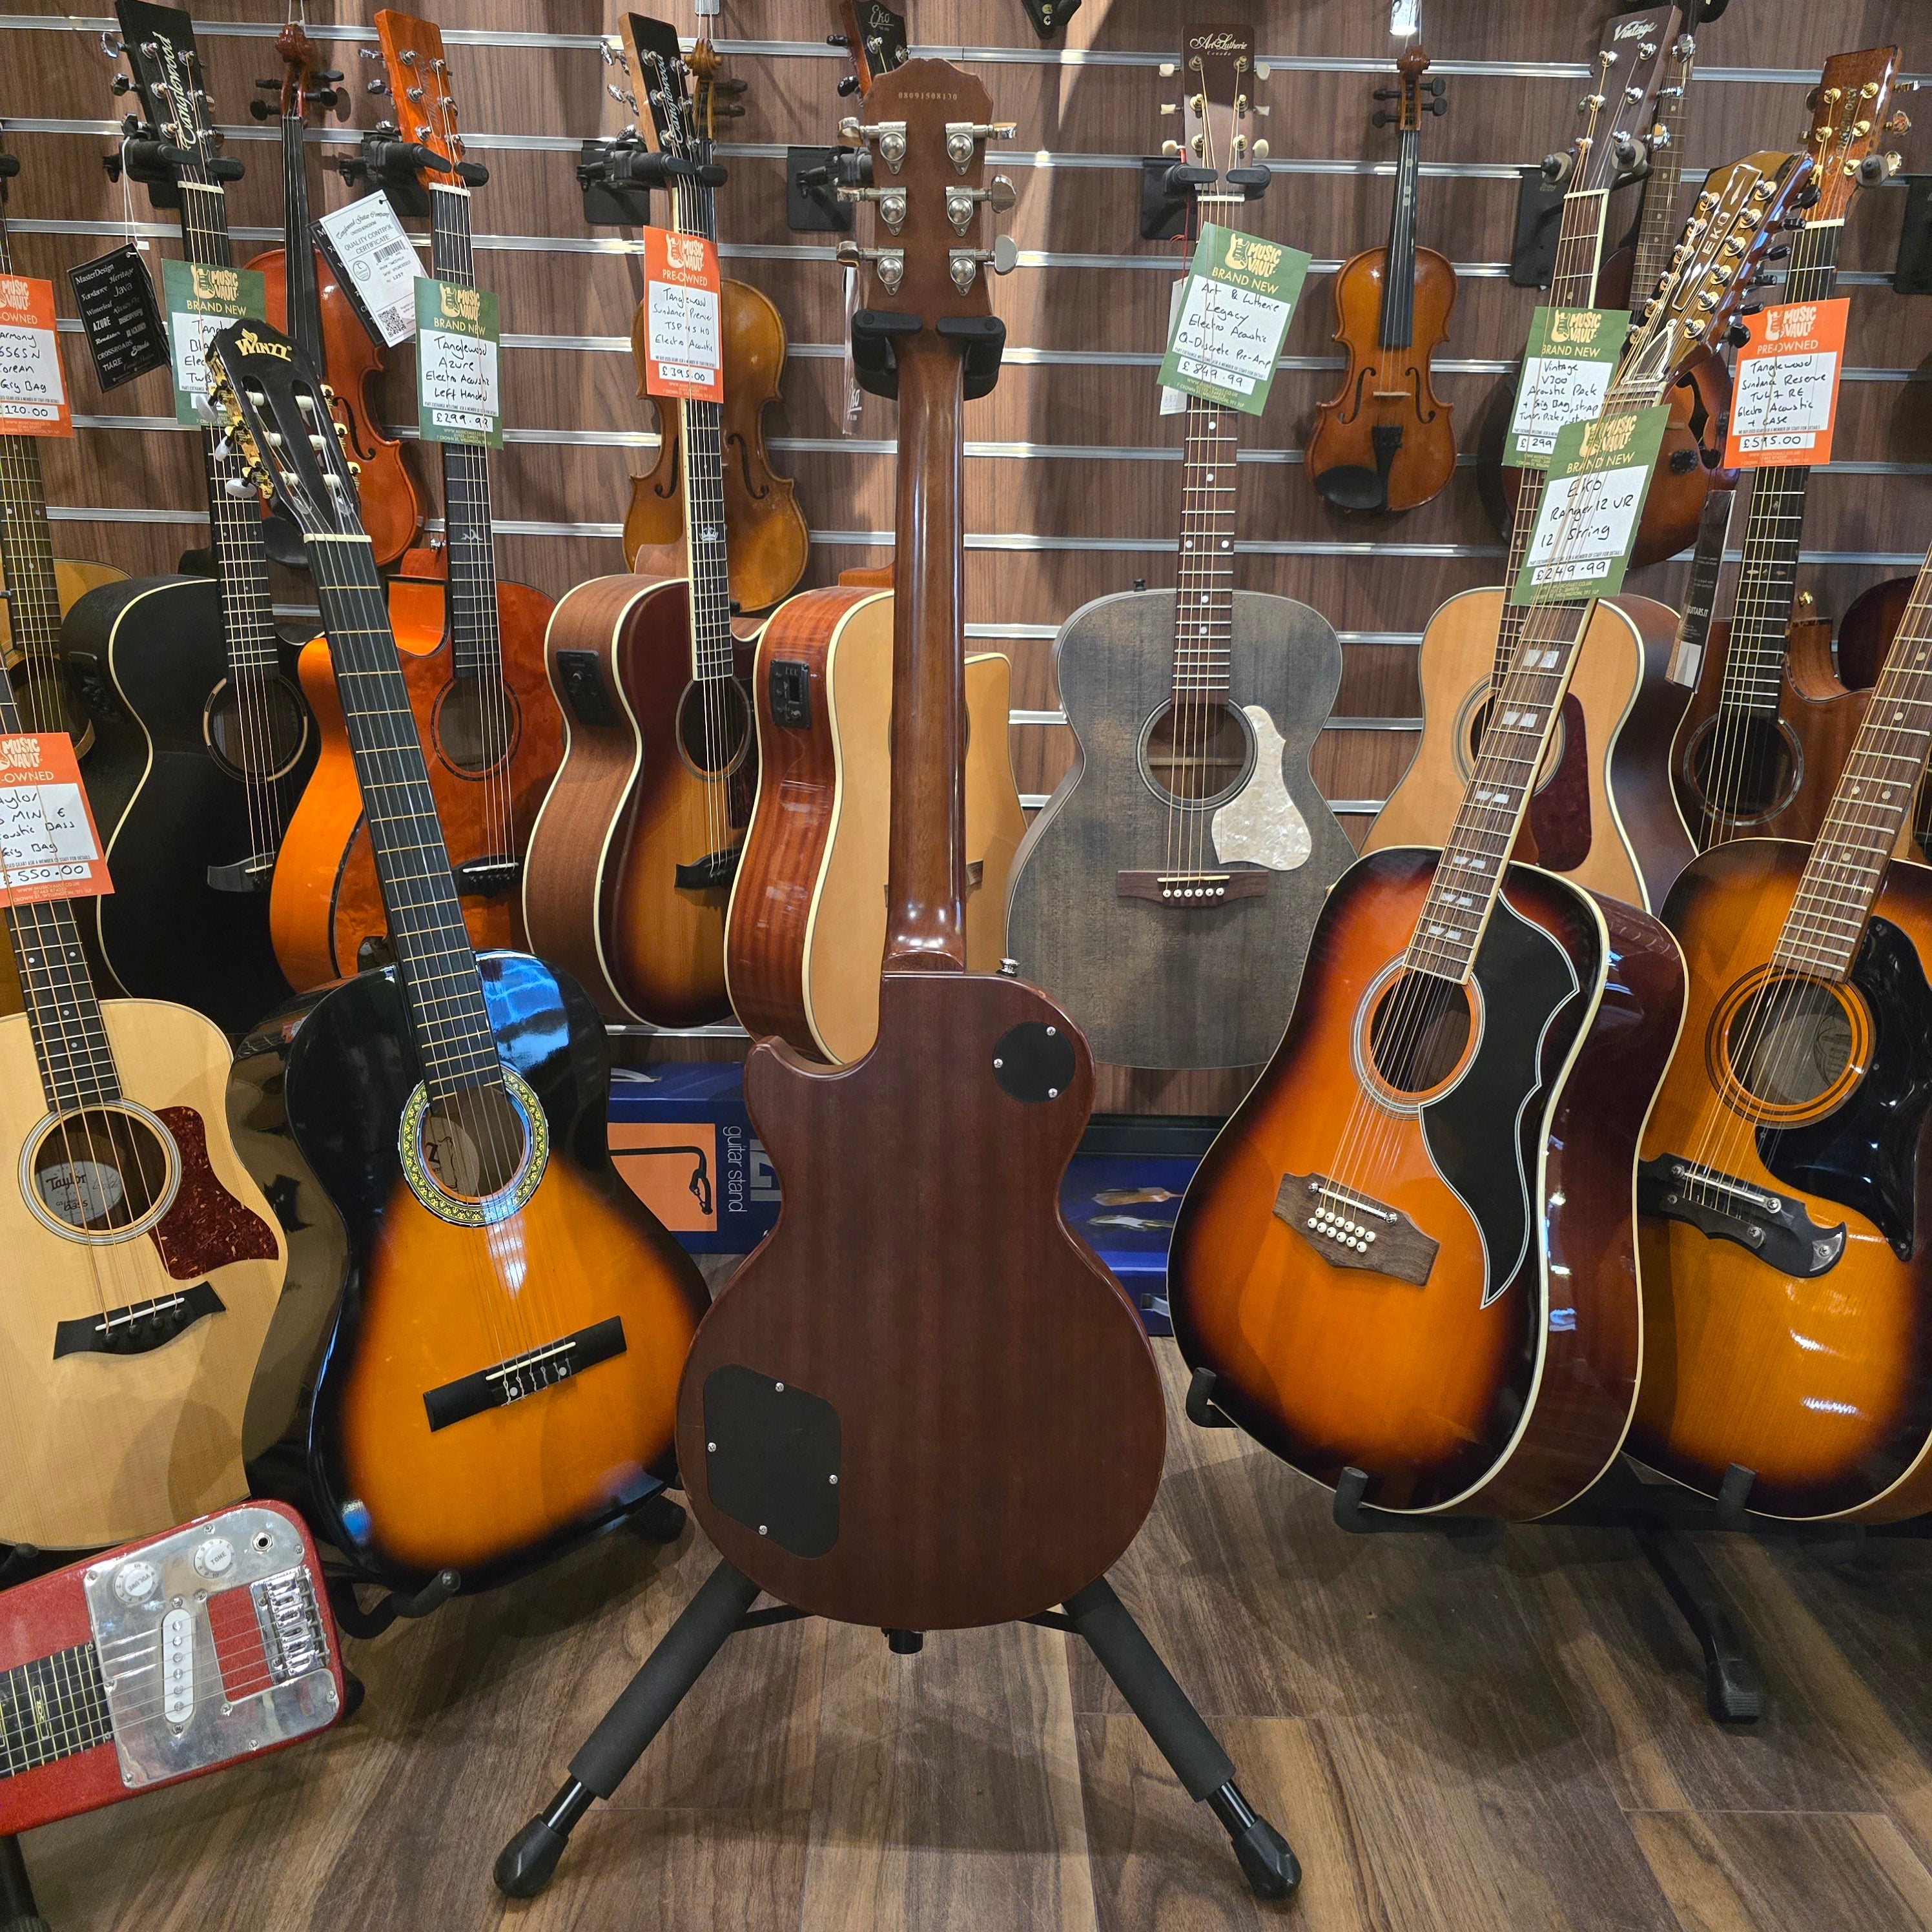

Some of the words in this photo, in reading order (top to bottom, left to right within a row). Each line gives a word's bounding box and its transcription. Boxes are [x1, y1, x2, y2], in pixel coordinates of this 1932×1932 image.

[869, 5, 890, 28] Eko
[1614, 18, 1658, 41] Vintage
[344, 235, 367, 251] QUALITY
[367, 223, 393, 239] CONTROL
[1702, 212, 1731, 255] EKO
[356, 234, 391, 254] CERTIFICATE
[683, 240, 704, 257] MUSIC
[1248, 243, 1282, 264] MUSIC
[684, 255, 703, 272] VAULT
[1248, 257, 1276, 278] VAULT
[75, 263, 114, 285] MasterDesign
[211, 269, 238, 287] MUSIC
[663, 269, 708, 287] PRE-OWNED
[1211, 267, 1249, 286] BRAND
[1251, 280, 1279, 294] NEW
[2, 280, 29, 296] MUSIC
[114, 282, 132, 298] Java
[214, 284, 238, 301] VAULT
[1202, 283, 1222, 295] Art
[1231, 289, 1238, 300] &
[6, 295, 28, 310] VAULT
[458, 289, 480, 306] MUSIC
[86, 300, 112, 316] Winterleaf
[186, 300, 222, 313] BRAND
[225, 303, 247, 316] NEW
[460, 305, 479, 321] VAULT
[1206, 303, 1249, 327] Legacy
[1783, 305, 1817, 322] MUSIC
[93, 316, 111, 332] AZURE
[434, 318, 466, 332] BRAND
[469, 324, 486, 336] NEW
[1569, 312, 1601, 328] MUSIC
[1570, 327, 1597, 343] VAULT
[1785, 322, 1813, 338] VAULT
[98, 340, 133, 360] CROSSROADS
[1541, 345, 1572, 355] BRAND
[1574, 347, 1601, 358] NEW
[1757, 340, 1818, 355] PRE-OWNED
[103, 357, 123, 372] TIARE
[438, 356, 474, 371] Azure
[1545, 361, 1578, 375] Vintage
[1182, 361, 1243, 387] £849.99
[435, 387, 456, 400] Left
[1573, 384, 1597, 396] Pack
[1605, 415, 1637, 436] MUSIC
[1603, 432, 1631, 452] VAULT
[1567, 459, 1603, 474] BRAND
[1606, 452, 1635, 467] NEW
[1596, 498, 1608, 510] 12
[1541, 534, 1553, 548] 12
[1567, 526, 1610, 540] String
[3, 737, 40, 755] MUSIC
[8, 752, 41, 769] VAULT
[723, 1125, 747, 1167] guitar
[46, 1173, 86, 1191] Taylor
[728, 1170, 748, 1212] stand
[64, 1200, 88, 1211] bass
